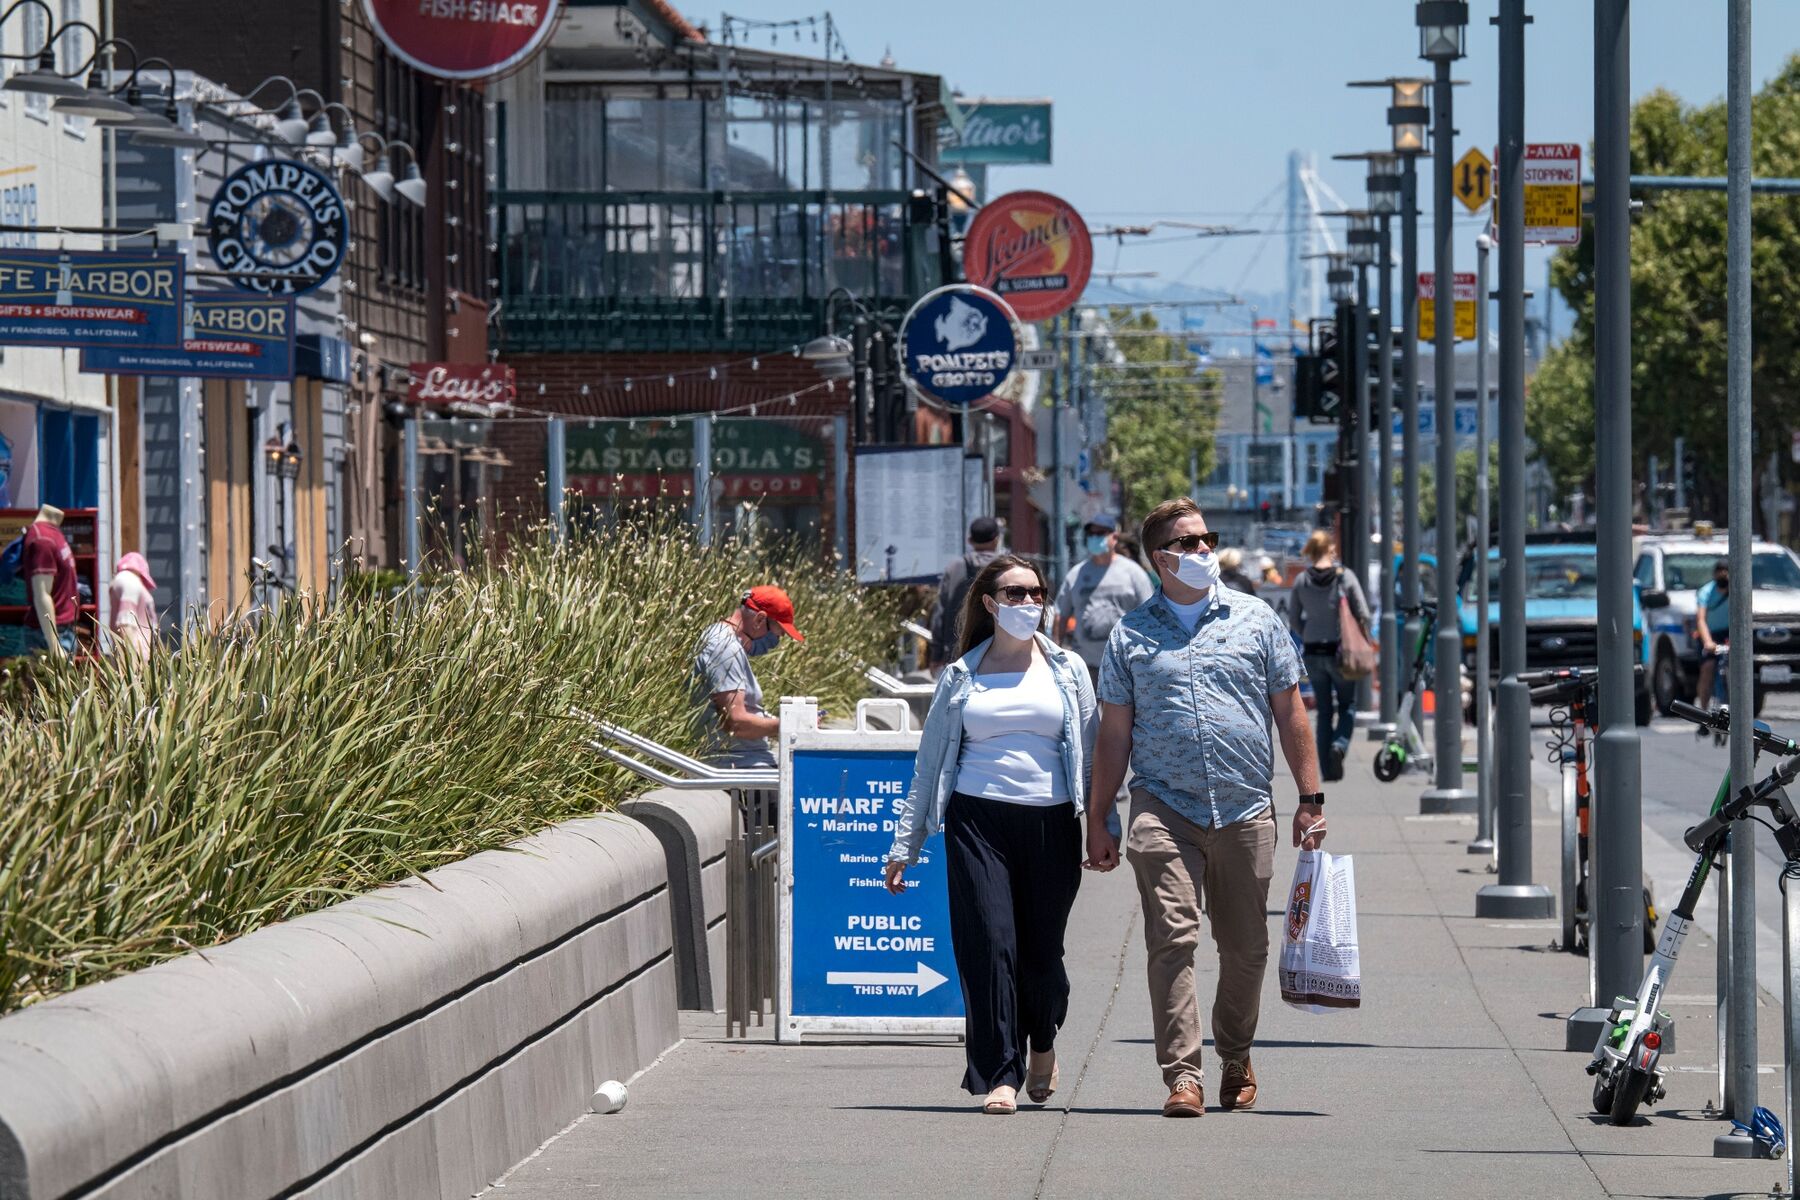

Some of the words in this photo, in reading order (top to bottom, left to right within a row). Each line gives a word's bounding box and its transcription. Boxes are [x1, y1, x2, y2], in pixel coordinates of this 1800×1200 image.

[420, 0, 466, 19] FISH
[469, 1, 538, 26] SHACK
[1525, 168, 1574, 180] STOPPING
[213, 163, 341, 224] POMPEI'S
[45, 270, 173, 298] HARBOR
[44, 306, 134, 319] SPORTSWEAR
[74, 328, 138, 337] CALIFORNIA
[184, 341, 250, 352] ORTSWEAR
[196, 360, 254, 369] CALIFORNIA
[916, 351, 1010, 373] POMPEI'S
[866, 780, 903, 794] THE
[800, 797, 884, 815] WHARF
[823, 819, 878, 832] Marine
[840, 853, 878, 863] Marine
[849, 877, 888, 889] Fishing
[904, 880, 920, 888] ear
[848, 915, 922, 931] PUBLIC
[834, 936, 935, 952] WELCOME
[853, 985, 883, 995] THIS
[886, 985, 914, 995] WAY
